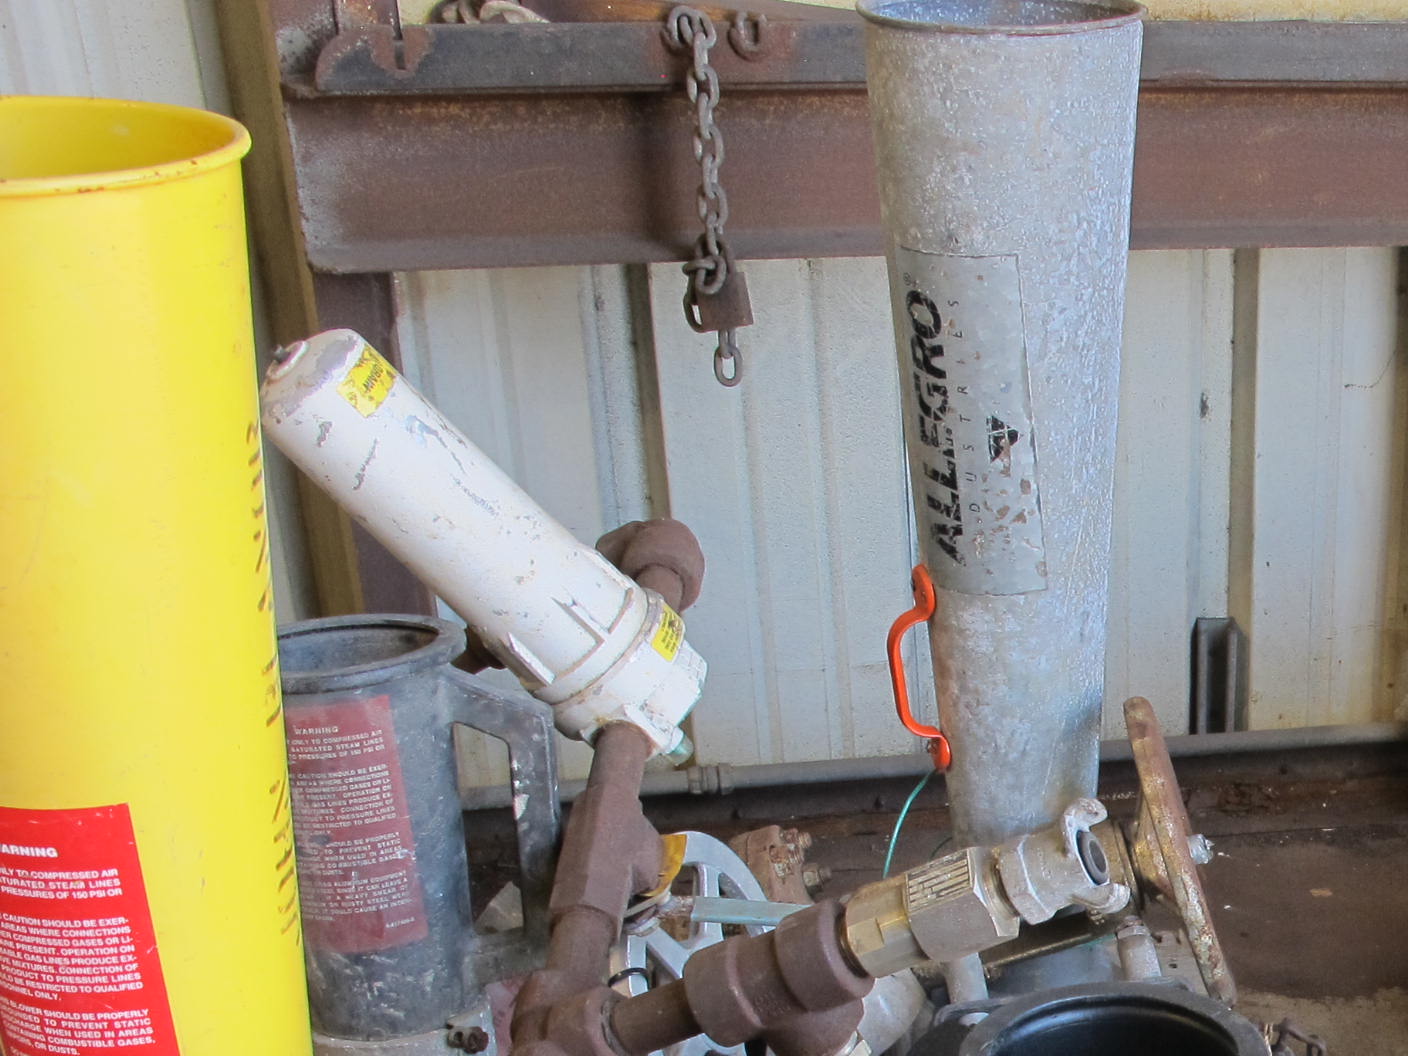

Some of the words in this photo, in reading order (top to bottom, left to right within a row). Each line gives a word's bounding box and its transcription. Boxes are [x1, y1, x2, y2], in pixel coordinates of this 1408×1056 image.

[906, 291, 965, 564] ALLEGRO
[295, 726, 339, 735] WARNING
[336, 742, 360, 750] STEAM
[364, 737, 384, 746] LINES
[0, 844, 58, 857] ARNING
[31, 870, 98, 880] COMPRESSED
[101, 868, 118, 877] AIR
[49, 881, 85, 889] STEAM
[89, 878, 120, 888] LINES
[0, 886, 55, 899] PRESSURES
[56, 890, 69, 899] OF
[72, 891, 88, 899] 150
[90, 890, 106, 898] PSI
[107, 888, 123, 896] OR
[2, 912, 41, 925] CAUTION
[42, 918, 82, 927] SHOULD
[83, 919, 97, 927] BE
[99, 917, 129, 926] EXER-
[0, 922, 27, 934] AREAS
[28, 927, 61, 937] WHERE
[62, 926, 131, 938] CONNECTIONS
[13, 933, 70, 946] COMPRESSED
[71, 938, 104, 946] GASES
[105, 937, 119, 945] OR
[61, 946, 117, 956] OPERATION
[119, 944, 135, 953] ON
[24, 952, 42, 962] GAS
[44, 955, 70, 964] LINES
[71, 955, 119, 965] PRODUCE
[120, 954, 137, 962] EX-
[0, 964, 39, 979] PRODUCT
[41, 974, 54, 982] TO
[56, 975, 109, 984] PRESSURE
[111, 972, 141, 982] LINES
[59, 964, 123, 974] CONNECTION
[124, 963, 138, 972] OF
[25, 979, 78, 993] RESTRICTED
[80, 984, 92, 993] TO
[94, 982, 144, 993] QUALIFIED
[10, 1000, 42, 1016] BLOWER
[43, 1010, 80, 1020] SHOULD
[82, 1012, 96, 1020] BE
[97, 1009, 149, 1020] PROPERLY
[44, 1018, 57, 1026] TO
[62, 1021, 108, 1029] PREVENT
[114, 1018, 152, 1028] STATIC
[44, 1027, 71, 1037] WHEN
[74, 1029, 102, 1038] USED
[104, 1029, 115, 1038] IN
[118, 1027, 154, 1037] AREAS
[34, 1041, 47, 1050] OR
[47, 1036, 115, 1048] COMBUSTIBLE
